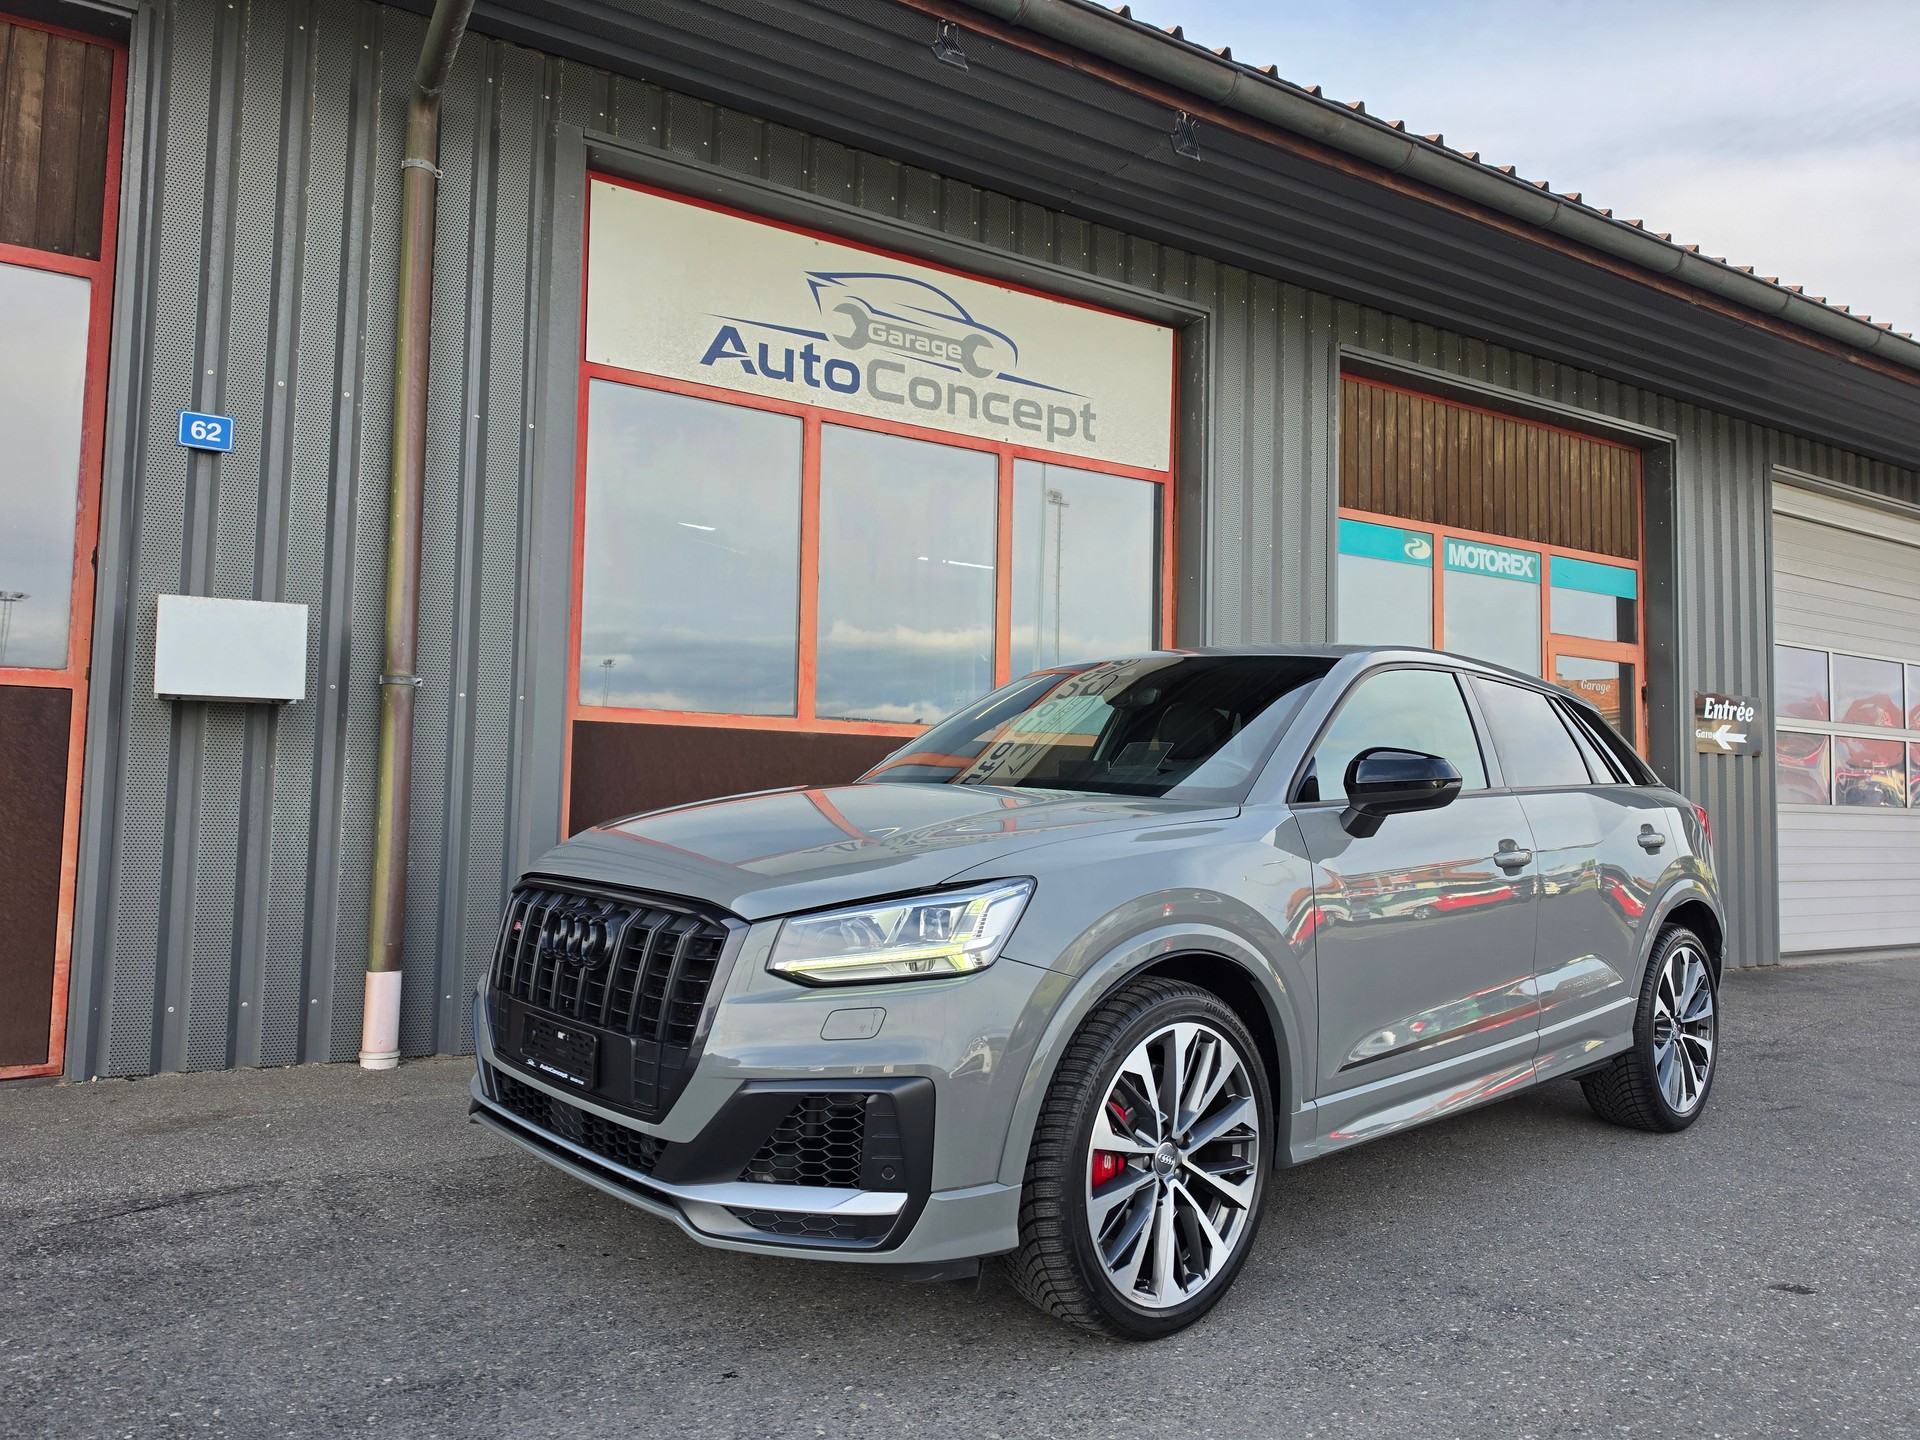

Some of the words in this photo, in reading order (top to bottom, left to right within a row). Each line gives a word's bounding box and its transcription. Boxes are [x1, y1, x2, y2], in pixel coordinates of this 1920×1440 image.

[866, 321, 963, 360] Garage
[190, 420, 222, 443] 62
[1448, 543, 1534, 578] MOTOREX
[1580, 679, 1611, 695] Garage
[1703, 697, 1755, 722] Entrée
[1695, 729, 1717, 741] Gara
